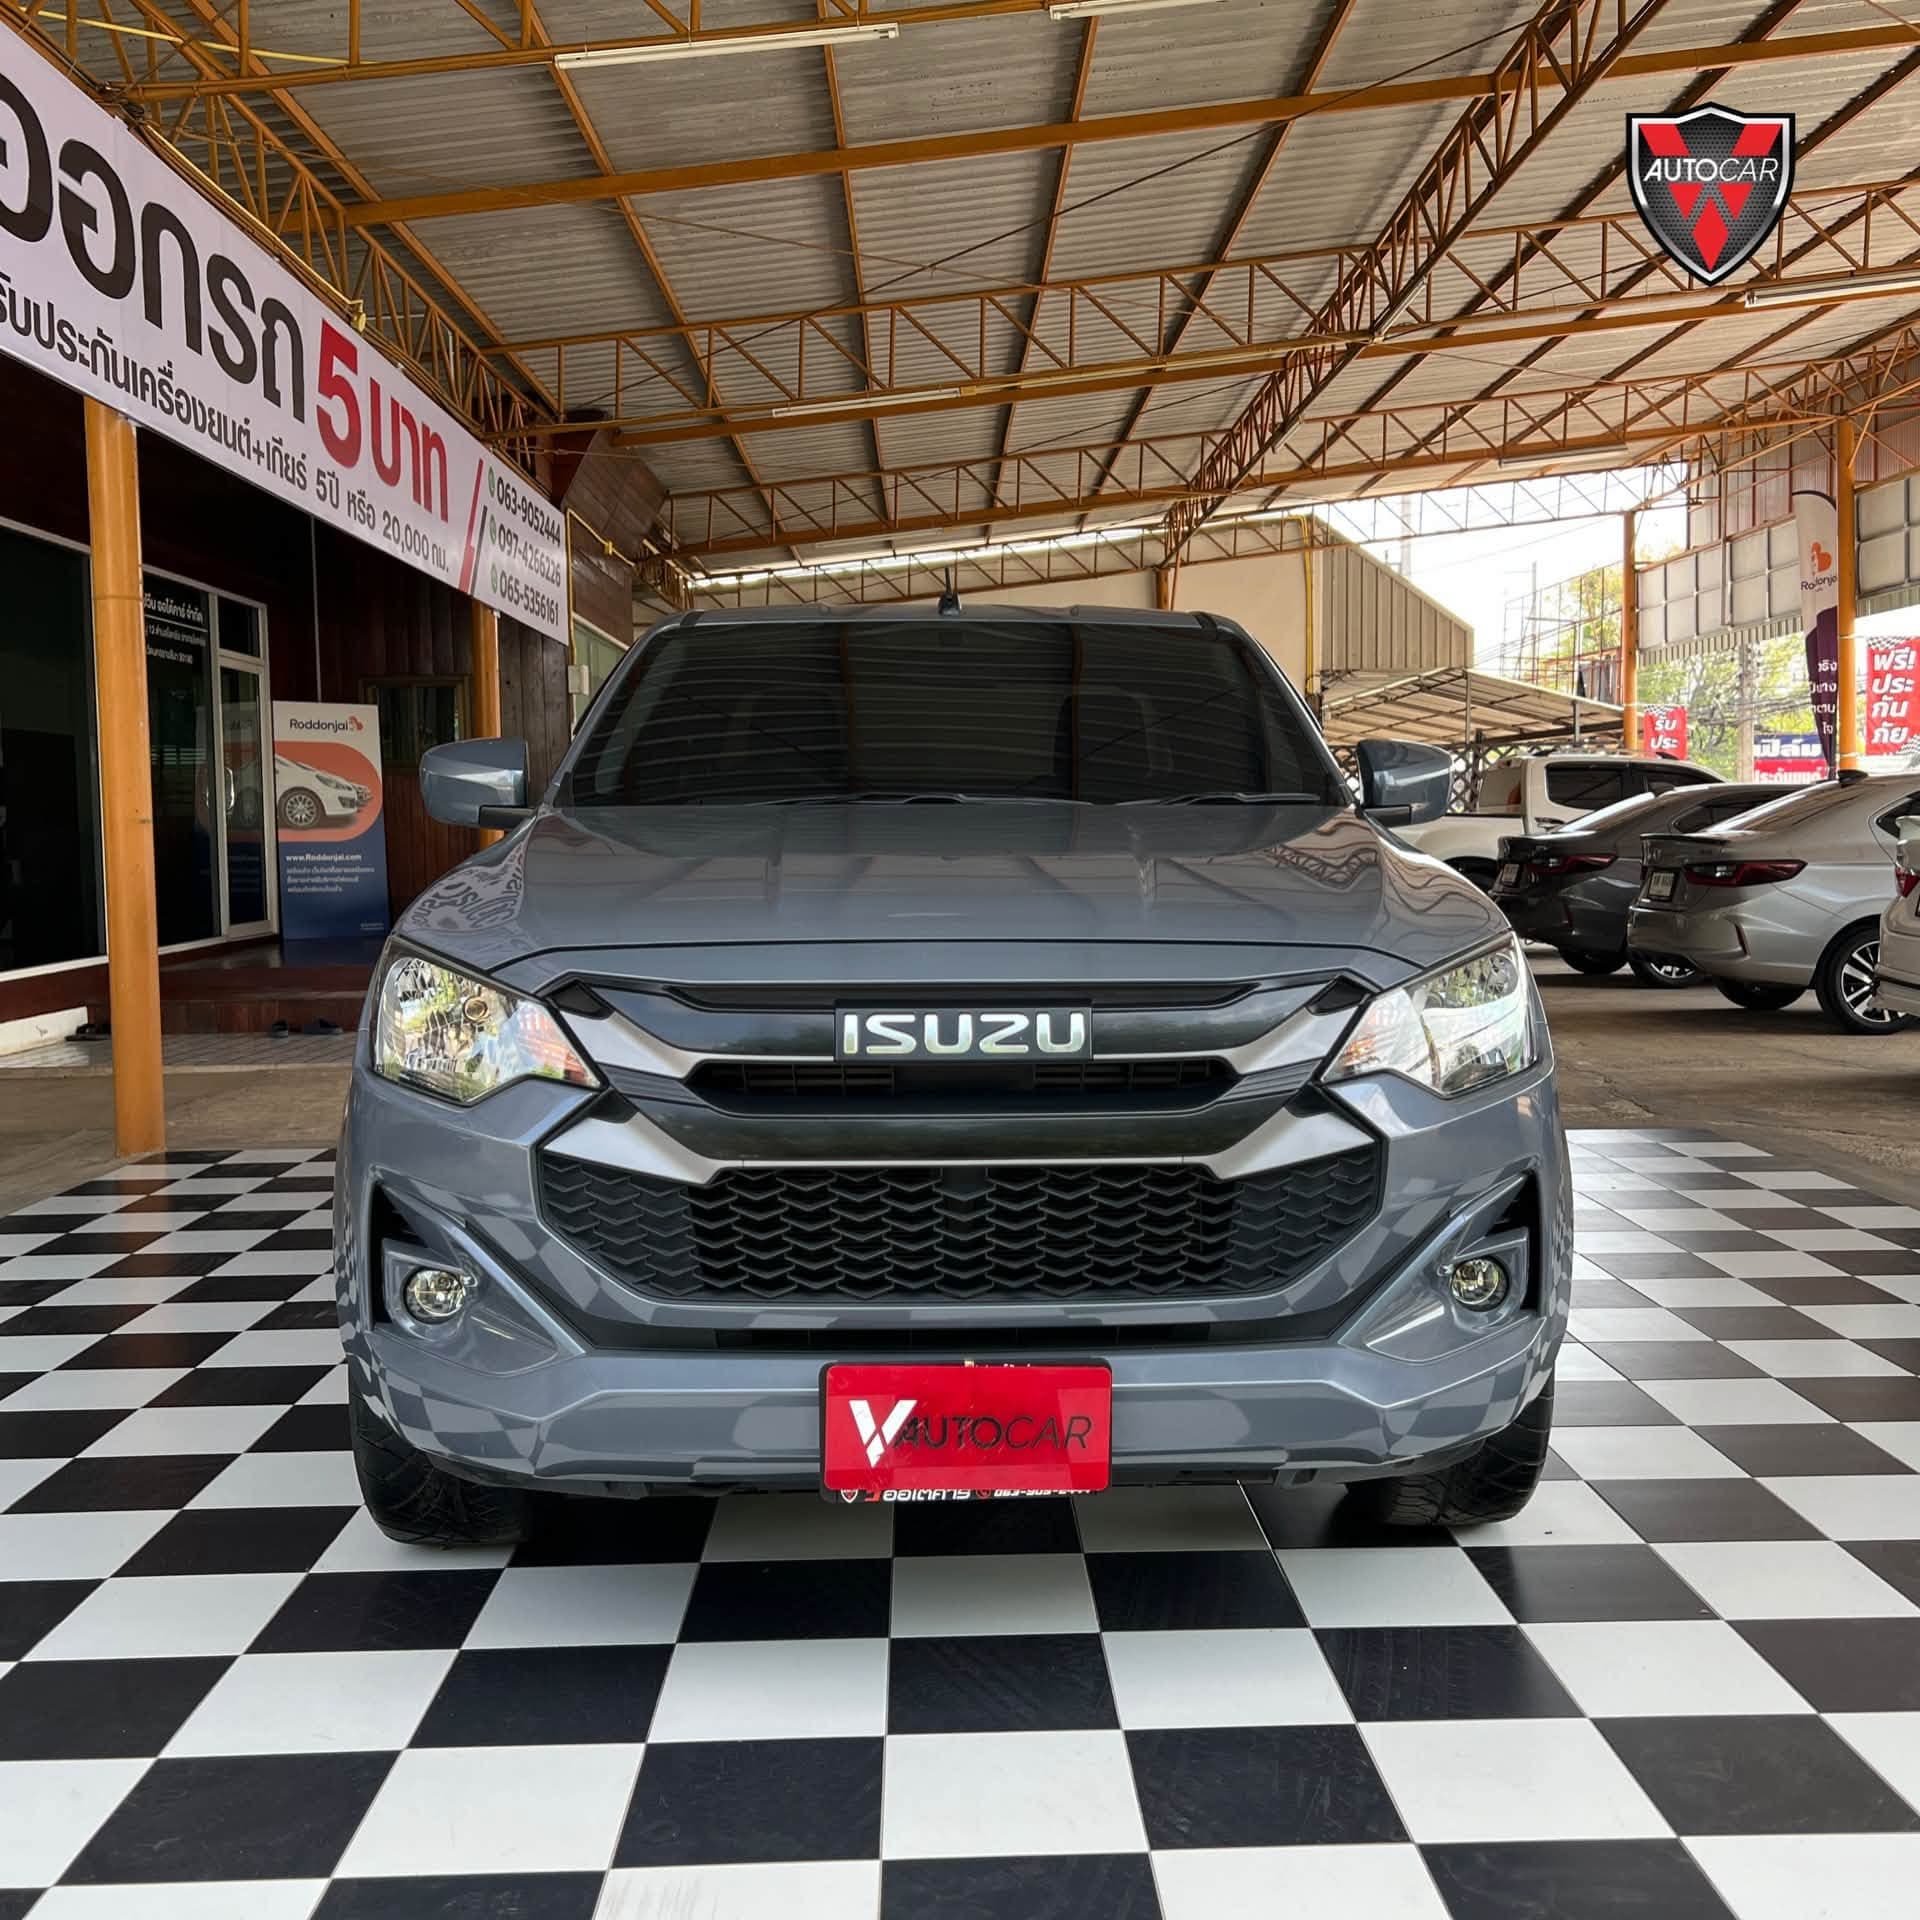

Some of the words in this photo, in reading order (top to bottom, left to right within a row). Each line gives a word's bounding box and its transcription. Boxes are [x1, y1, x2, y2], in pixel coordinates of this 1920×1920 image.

[346, 488, 376, 530] หรือ
[383, 510, 429, 562] 20,000
[432, 543, 449, 573] กม.
[497, 476, 560, 549] 063-9052444
[498, 523, 561, 588] 097-4266226
[499, 569, 559, 627] 065-5356161
[1871, 673, 1915, 693] ประ
[1871, 694, 1909, 718] กัน
[289, 718, 348, 733] Roddonjai
[1871, 721, 1909, 745] ภัย
[844, 1013, 1085, 1054] ISUZU
[895, 1415, 1094, 1450] AUTOCAR
